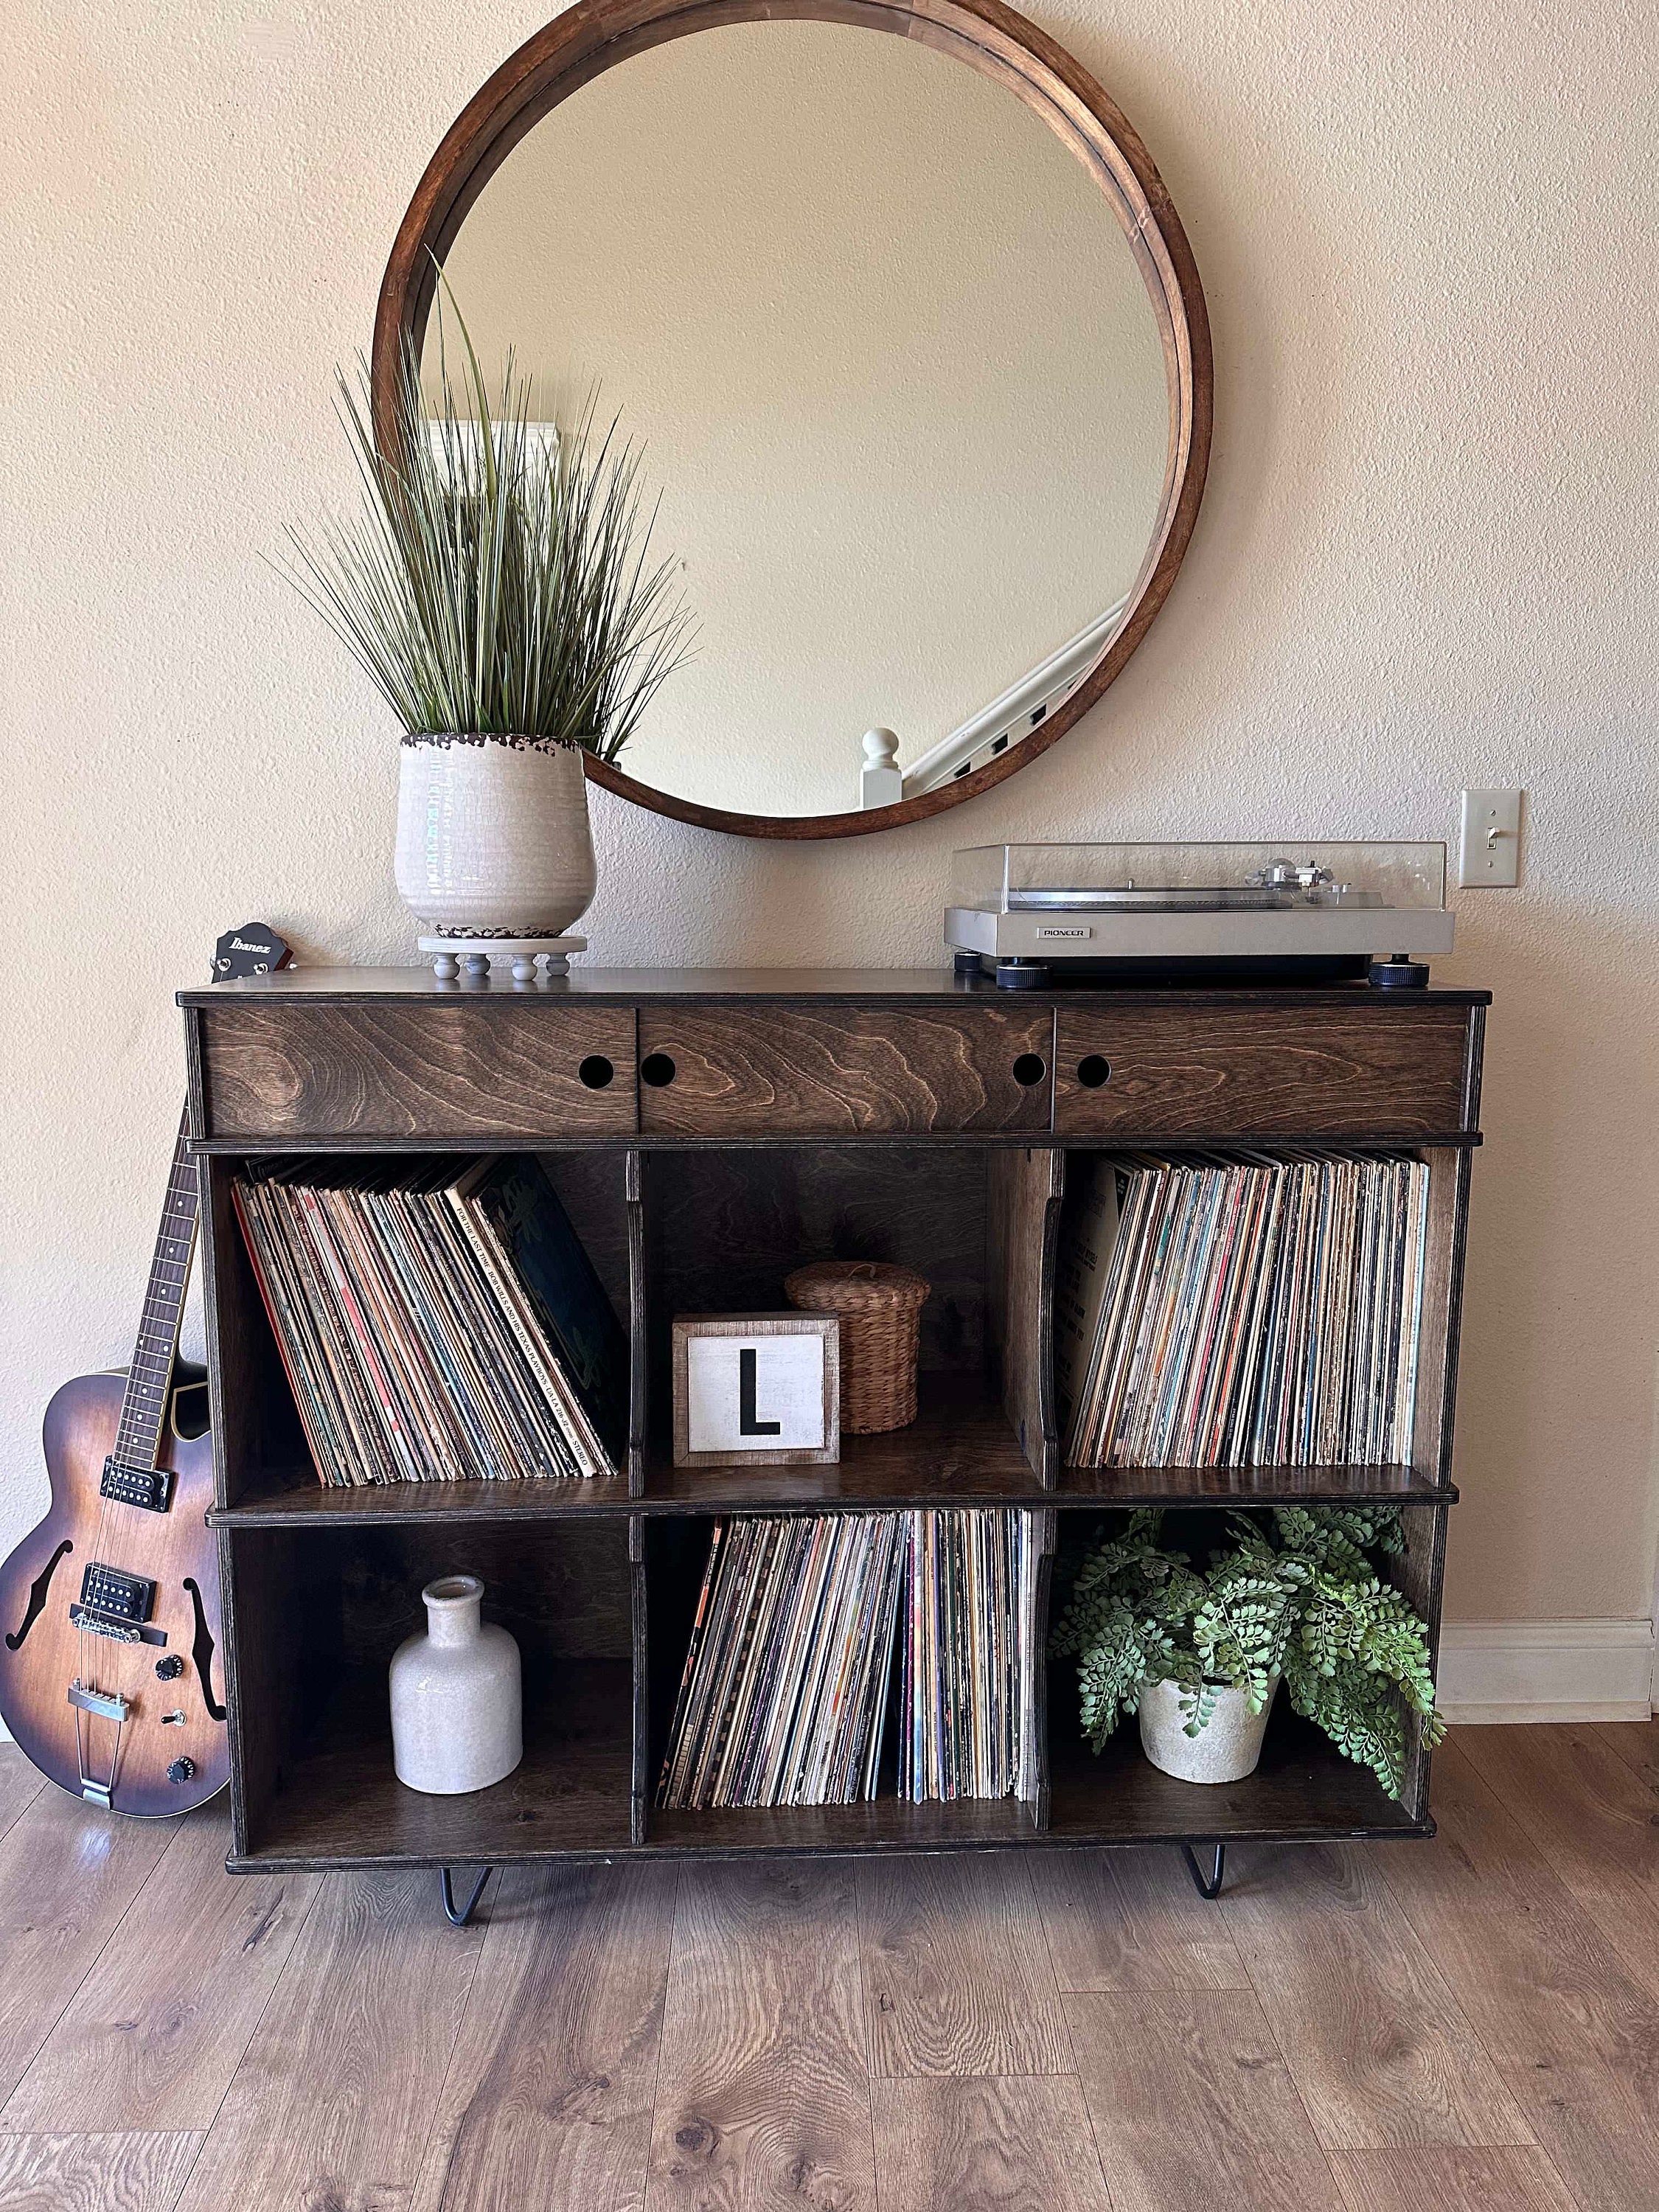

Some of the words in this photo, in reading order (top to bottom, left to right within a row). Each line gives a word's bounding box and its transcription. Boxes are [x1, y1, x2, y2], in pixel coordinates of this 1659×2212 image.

[229, 936, 272, 954] Ibanez
[456, 1207, 467, 1222] FOR
[463, 1221, 473, 1235] THE
[470, 1235, 482, 1253] LAST
[479, 1252, 490, 1269] TIME
[487, 1270, 498, 1285] BOB
[495, 1285, 508, 1305] WILLS
[504, 1304, 515, 1320] AND
[512, 1319, 521, 1332] HIS
[518, 1331, 532, 1352] TEXAS
[528, 1352, 548, 1385] PLAYBOYS
[571, 1440, 588, 1466] STEREO
[740, 1349, 781, 1436] L
